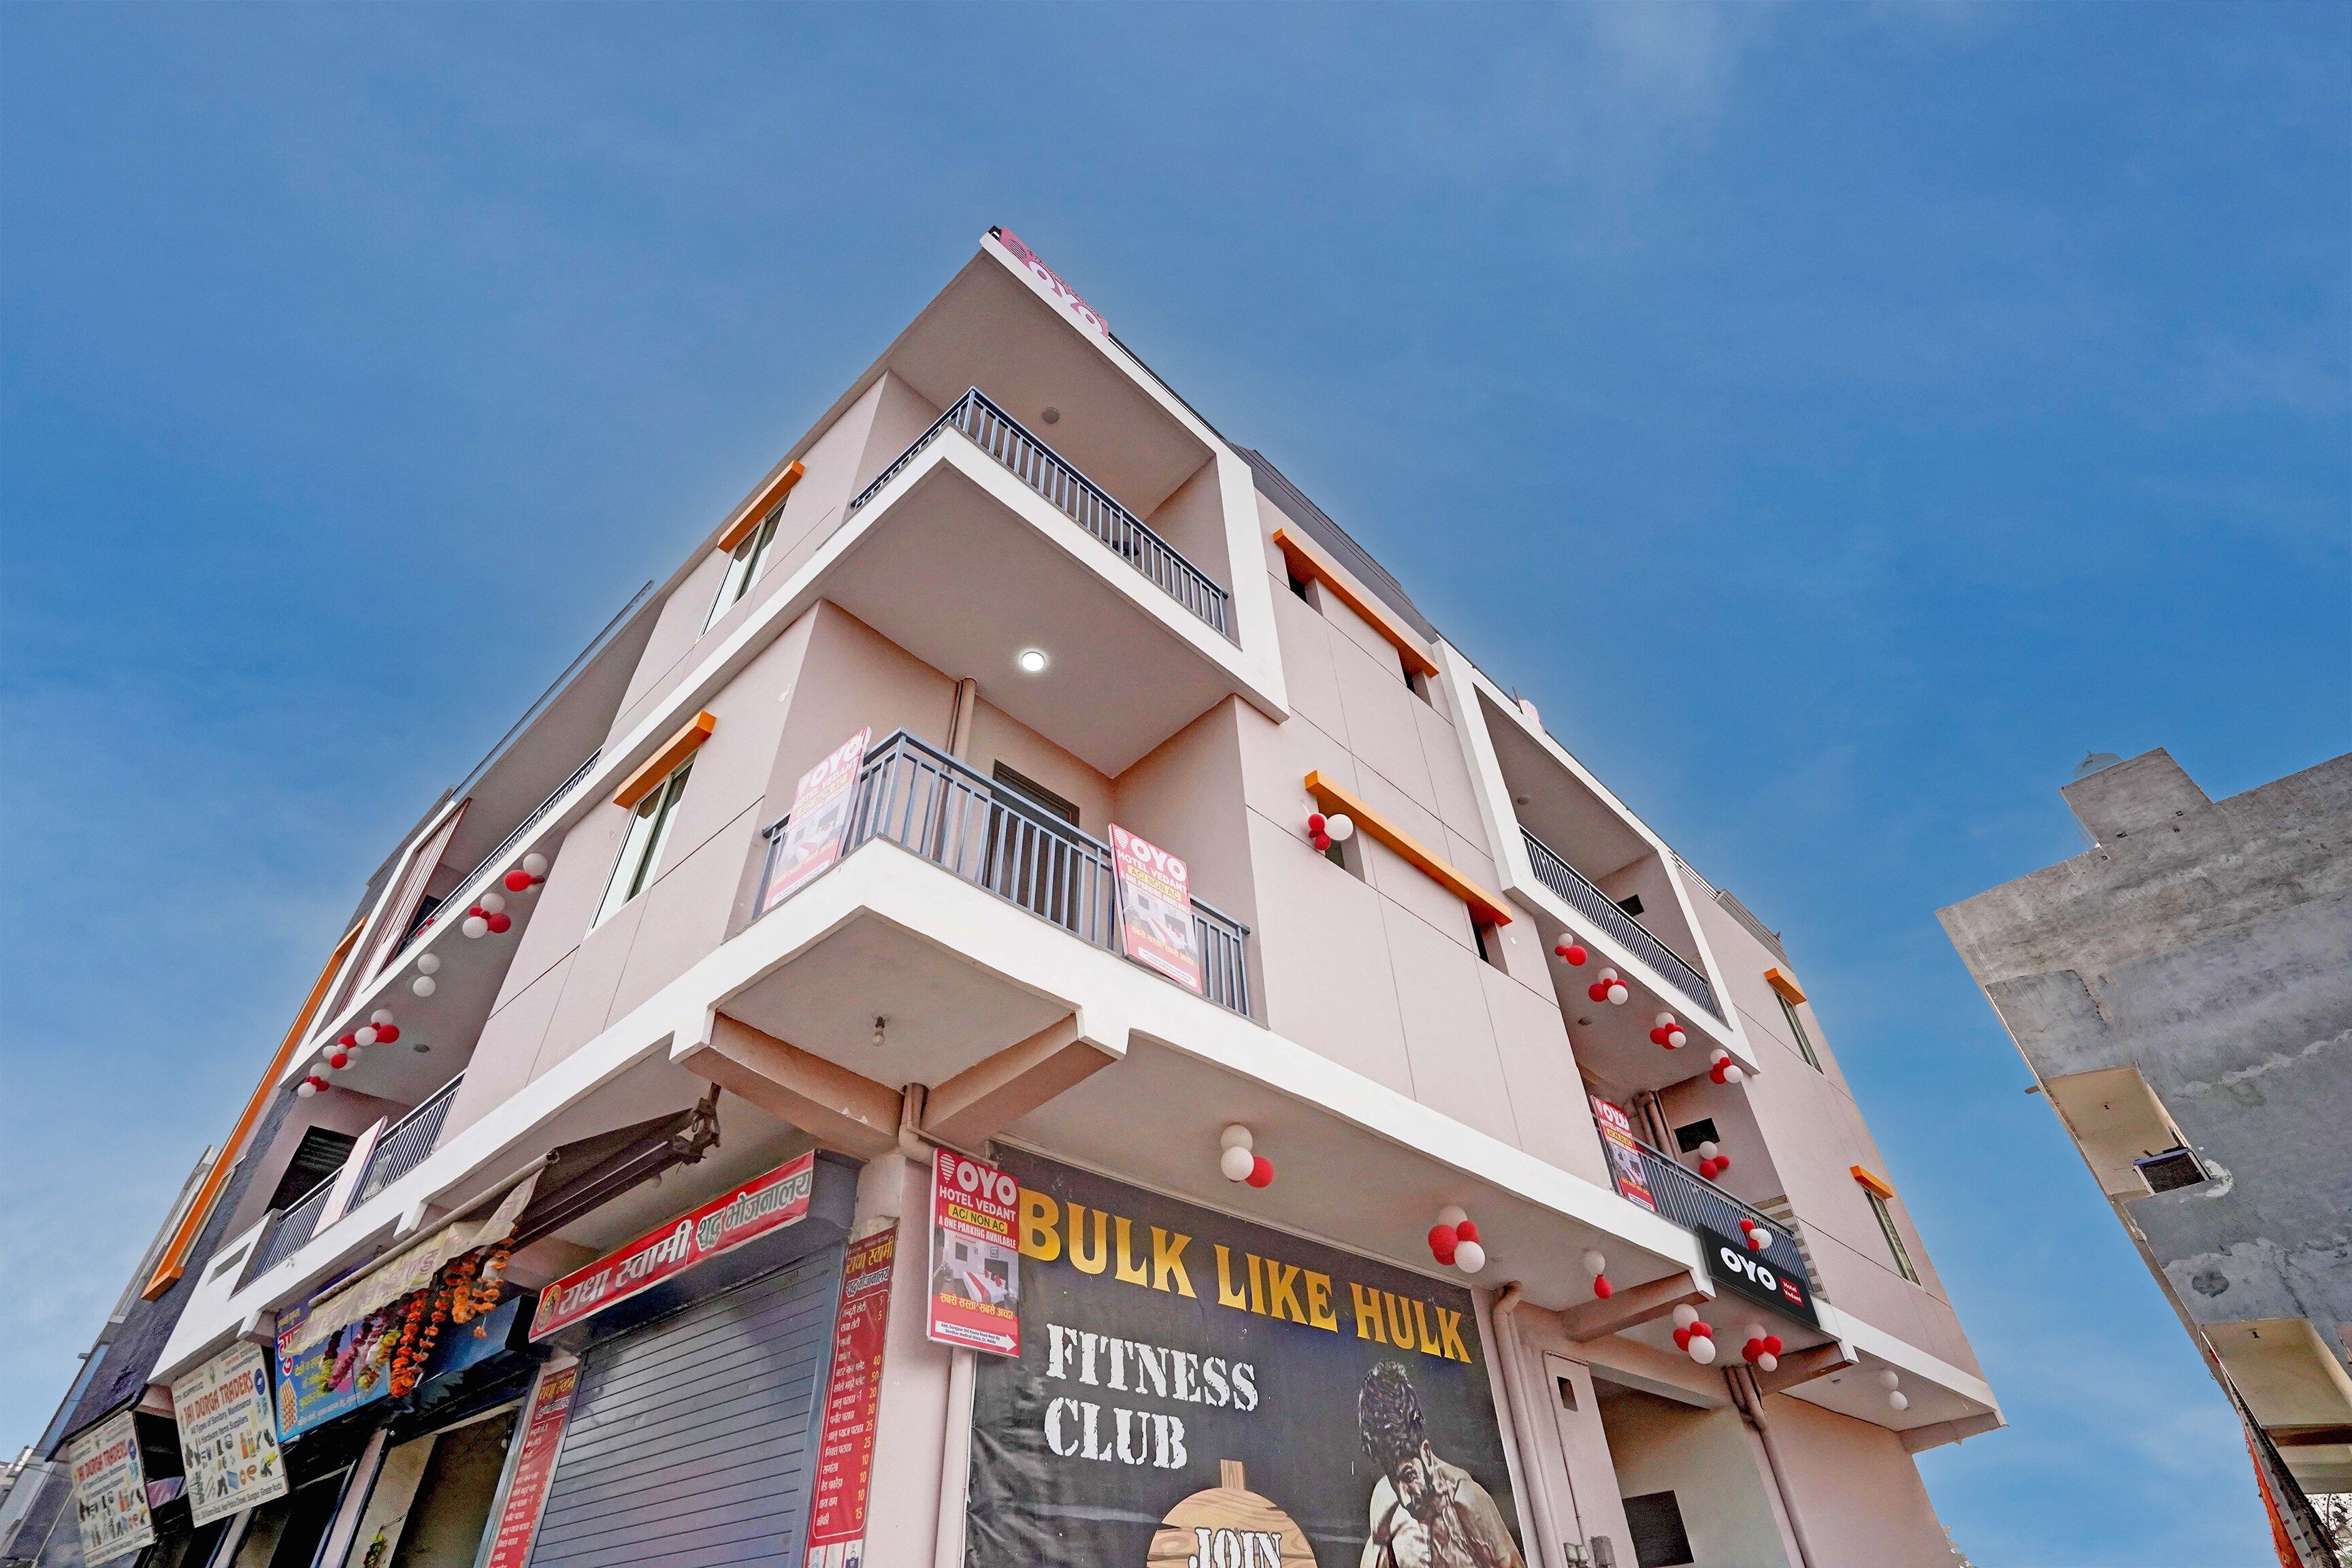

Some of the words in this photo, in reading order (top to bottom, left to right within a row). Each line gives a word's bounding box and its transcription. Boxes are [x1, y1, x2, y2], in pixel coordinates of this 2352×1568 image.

[1029, 261, 1103, 333] OYO
[811, 735, 862, 787] OYO
[1117, 849, 1149, 873] HOTEL
[1150, 867, 1188, 894] VEDANT
[1130, 838, 1187, 882] OYO
[1147, 876, 1166, 892] NON
[1168, 888, 1179, 899] AC
[957, 1161, 1017, 1206] OYO
[939, 1185, 973, 1208] HOTEL
[976, 1198, 1016, 1222] VEDANT
[938, 1215, 944, 1225] A
[944, 1217, 957, 1230] ONE
[958, 1222, 985, 1239] PARKING
[985, 1230, 1016, 1249] AVAILABLE
[951, 1206, 968, 1220] AC/
[970, 1214, 990, 1227] NON
[992, 1220, 1004, 1232] AC
[559, 1267, 612, 1315] राधा
[616, 1219, 693, 1288] स्वामी
[725, 1170, 813, 1232] भोजनालय
[868, 1235, 894, 1266] स्वामी
[1018, 1187, 1196, 1299] BULK
[1213, 1244, 1338, 1334] LIKE
[1350, 1282, 1472, 1364] HULK
[1720, 1247, 1777, 1291] OYO
[1783, 1281, 1797, 1293] Hotel
[1783, 1289, 1803, 1303] Vedant
[878, 1310, 882, 1320] 5
[940, 1292, 958, 1306] सबसे
[979, 1302, 996, 1316] सबसे
[996, 1307, 1013, 1320] अच्छा
[873, 1354, 881, 1366] 40
[1046, 1324, 1258, 1411] FITNESS
[219, 1369, 254, 1405] TRADERS
[870, 1370, 879, 1382] 50
[869, 1386, 877, 1399] 20
[867, 1403, 875, 1416] 30
[865, 1419, 873, 1432] 25
[1044, 1397, 1188, 1469] CLUB
[863, 1436, 871, 1449] 25
[862, 1453, 869, 1465] 10
[860, 1471, 867, 1484] 10
[858, 1489, 865, 1501] 10
[855, 1507, 863, 1520] 15
[1188, 1528, 1281, 1568] JOIN
